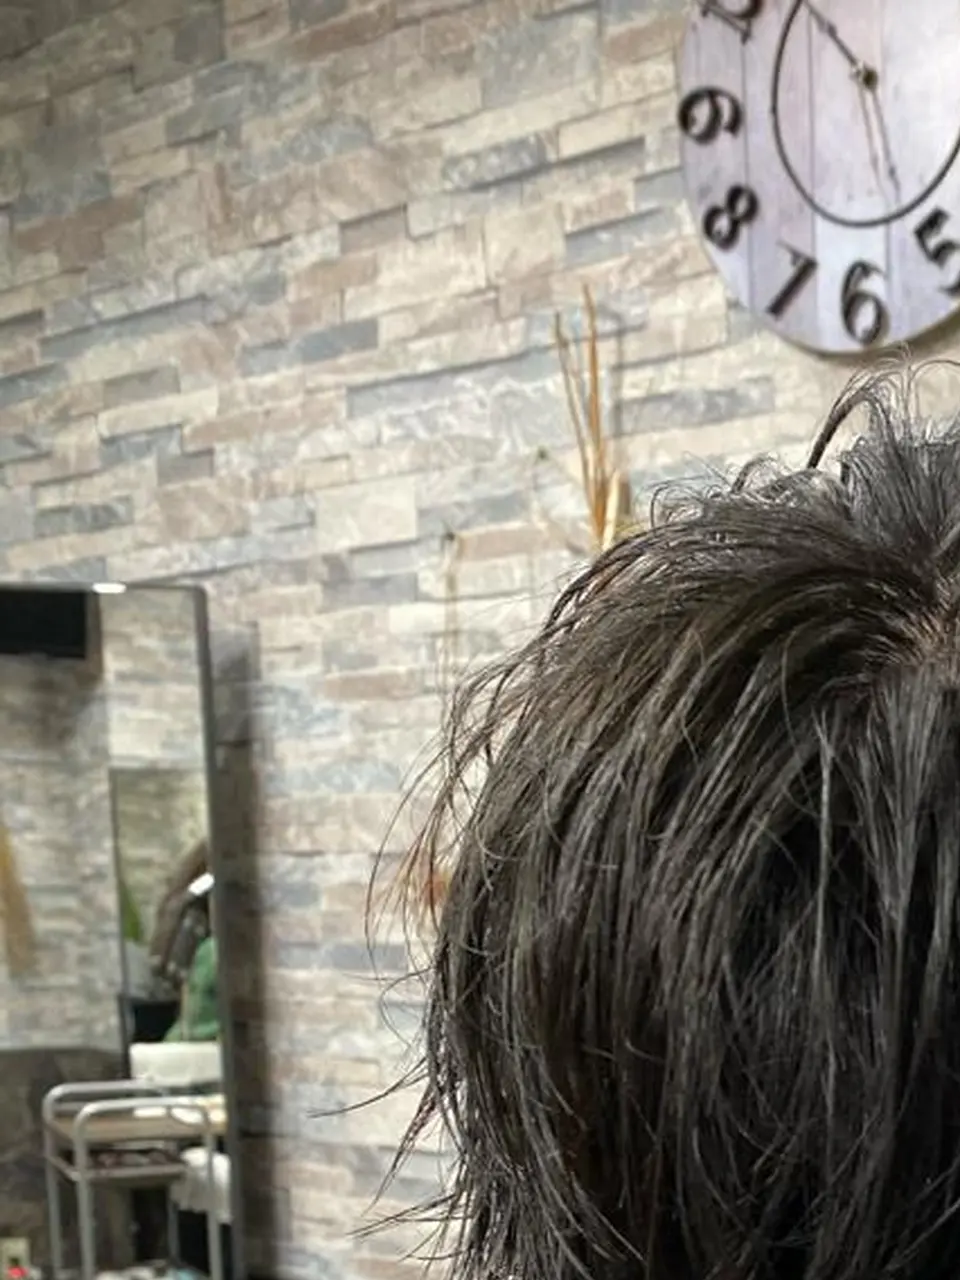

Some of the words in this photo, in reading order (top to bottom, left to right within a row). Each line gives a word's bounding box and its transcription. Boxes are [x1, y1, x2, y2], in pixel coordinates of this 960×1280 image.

[678, 86, 743, 145] 9
[703, 184, 759, 251] 8
[767, 241, 818, 321] 7
[840, 259, 890, 345] 6
